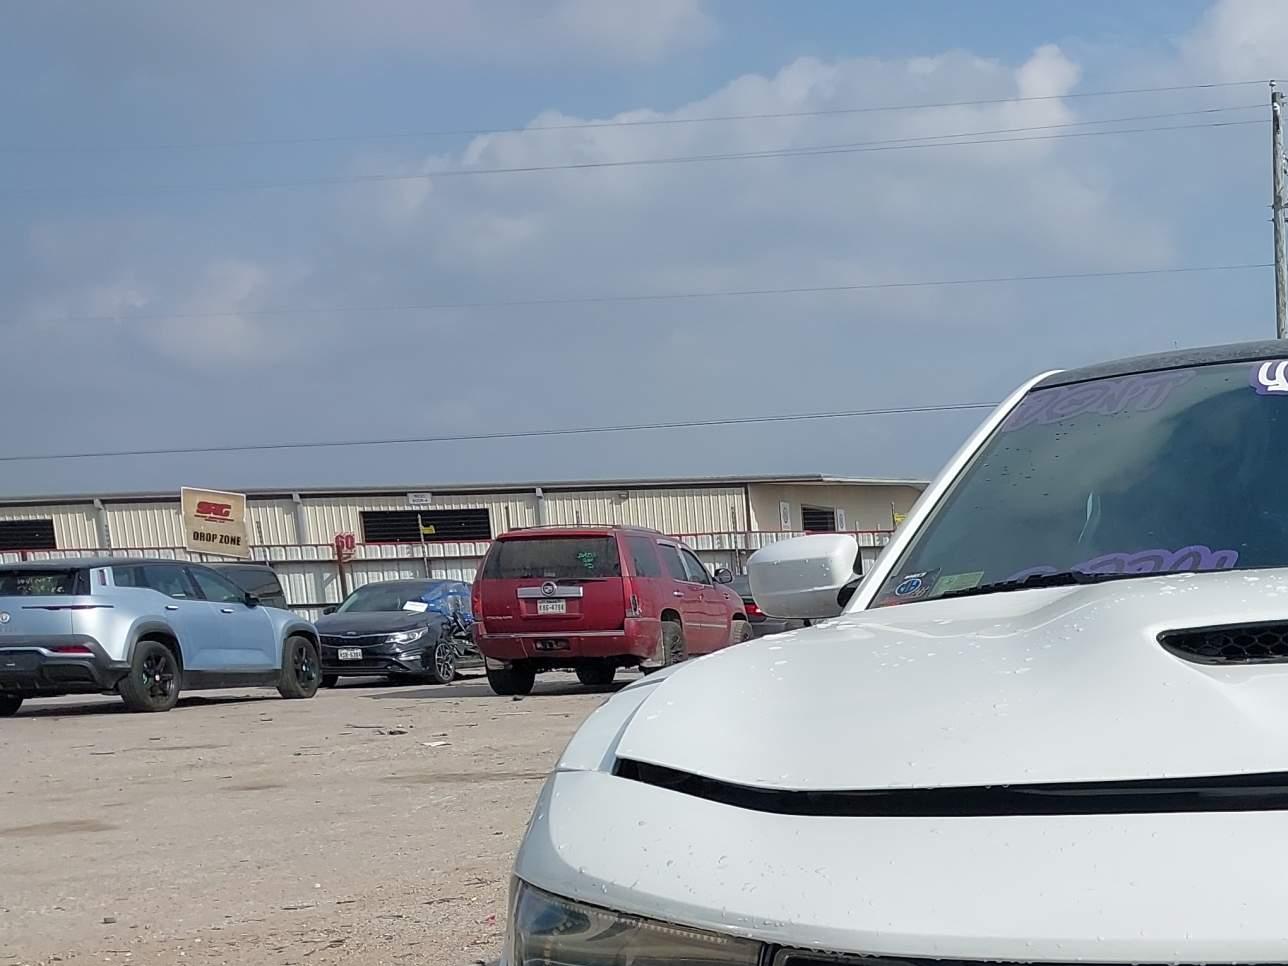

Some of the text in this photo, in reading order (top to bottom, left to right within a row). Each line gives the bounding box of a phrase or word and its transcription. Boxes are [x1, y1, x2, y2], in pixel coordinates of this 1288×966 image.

[193, 531, 241, 546] DROP ZONE
[335, 533, 356, 550] 60
